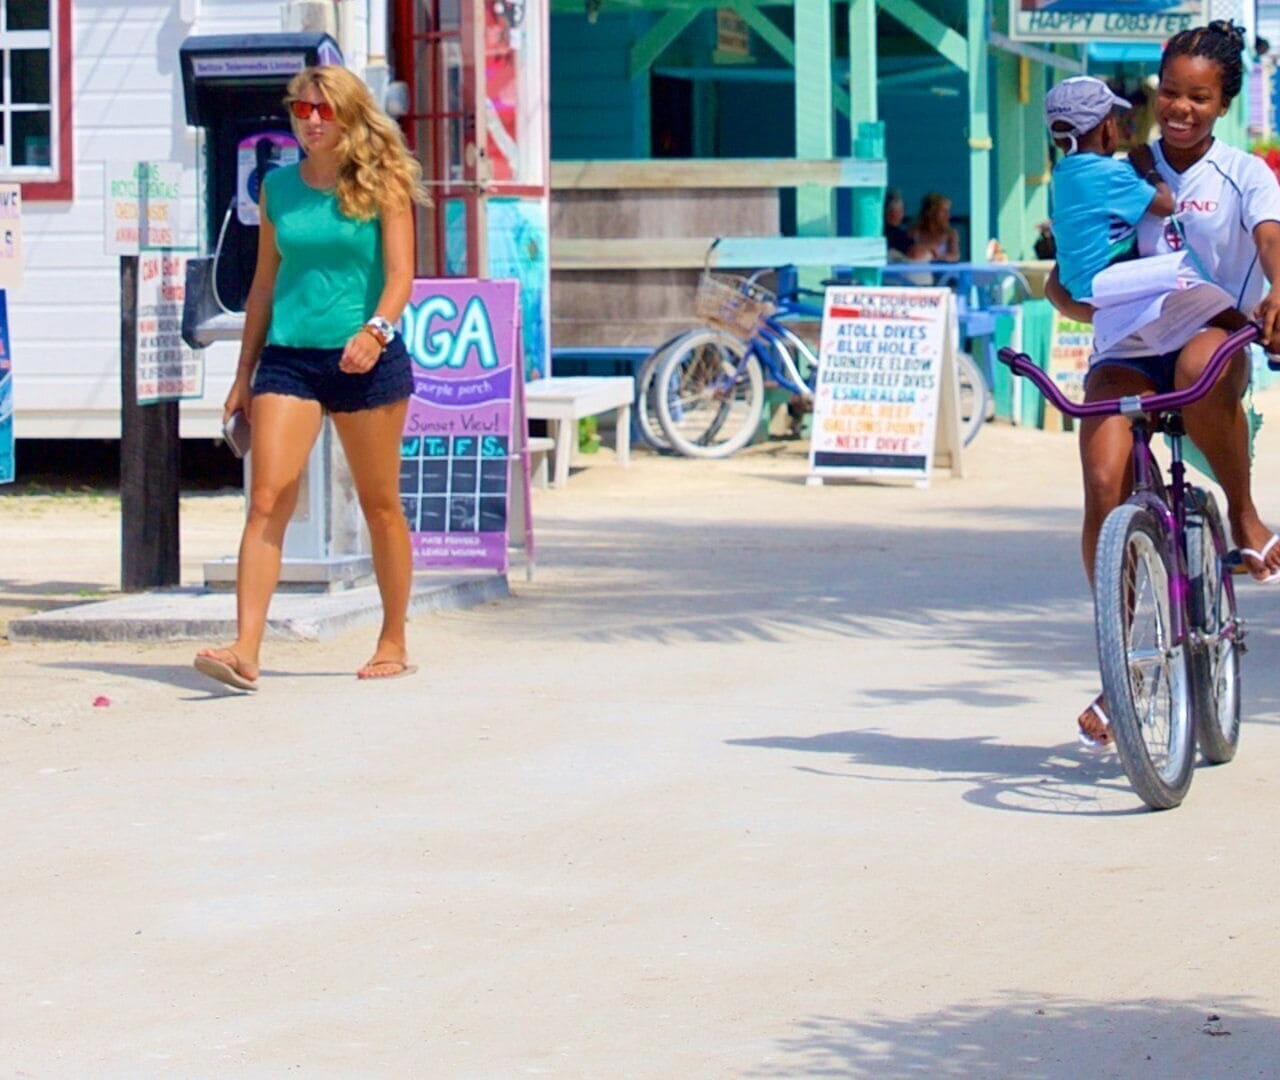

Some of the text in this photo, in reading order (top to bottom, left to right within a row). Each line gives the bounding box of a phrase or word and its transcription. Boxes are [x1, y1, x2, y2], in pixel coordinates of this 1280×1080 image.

[1028, 12, 1192, 32] HAPPY LOBSTER
[837, 324, 927, 340] ATOLL DIVES
[837, 340, 918, 356] BLUE HOLE
[407, 411, 500, 433] Sunset View!
[455, 438, 473, 457] F
